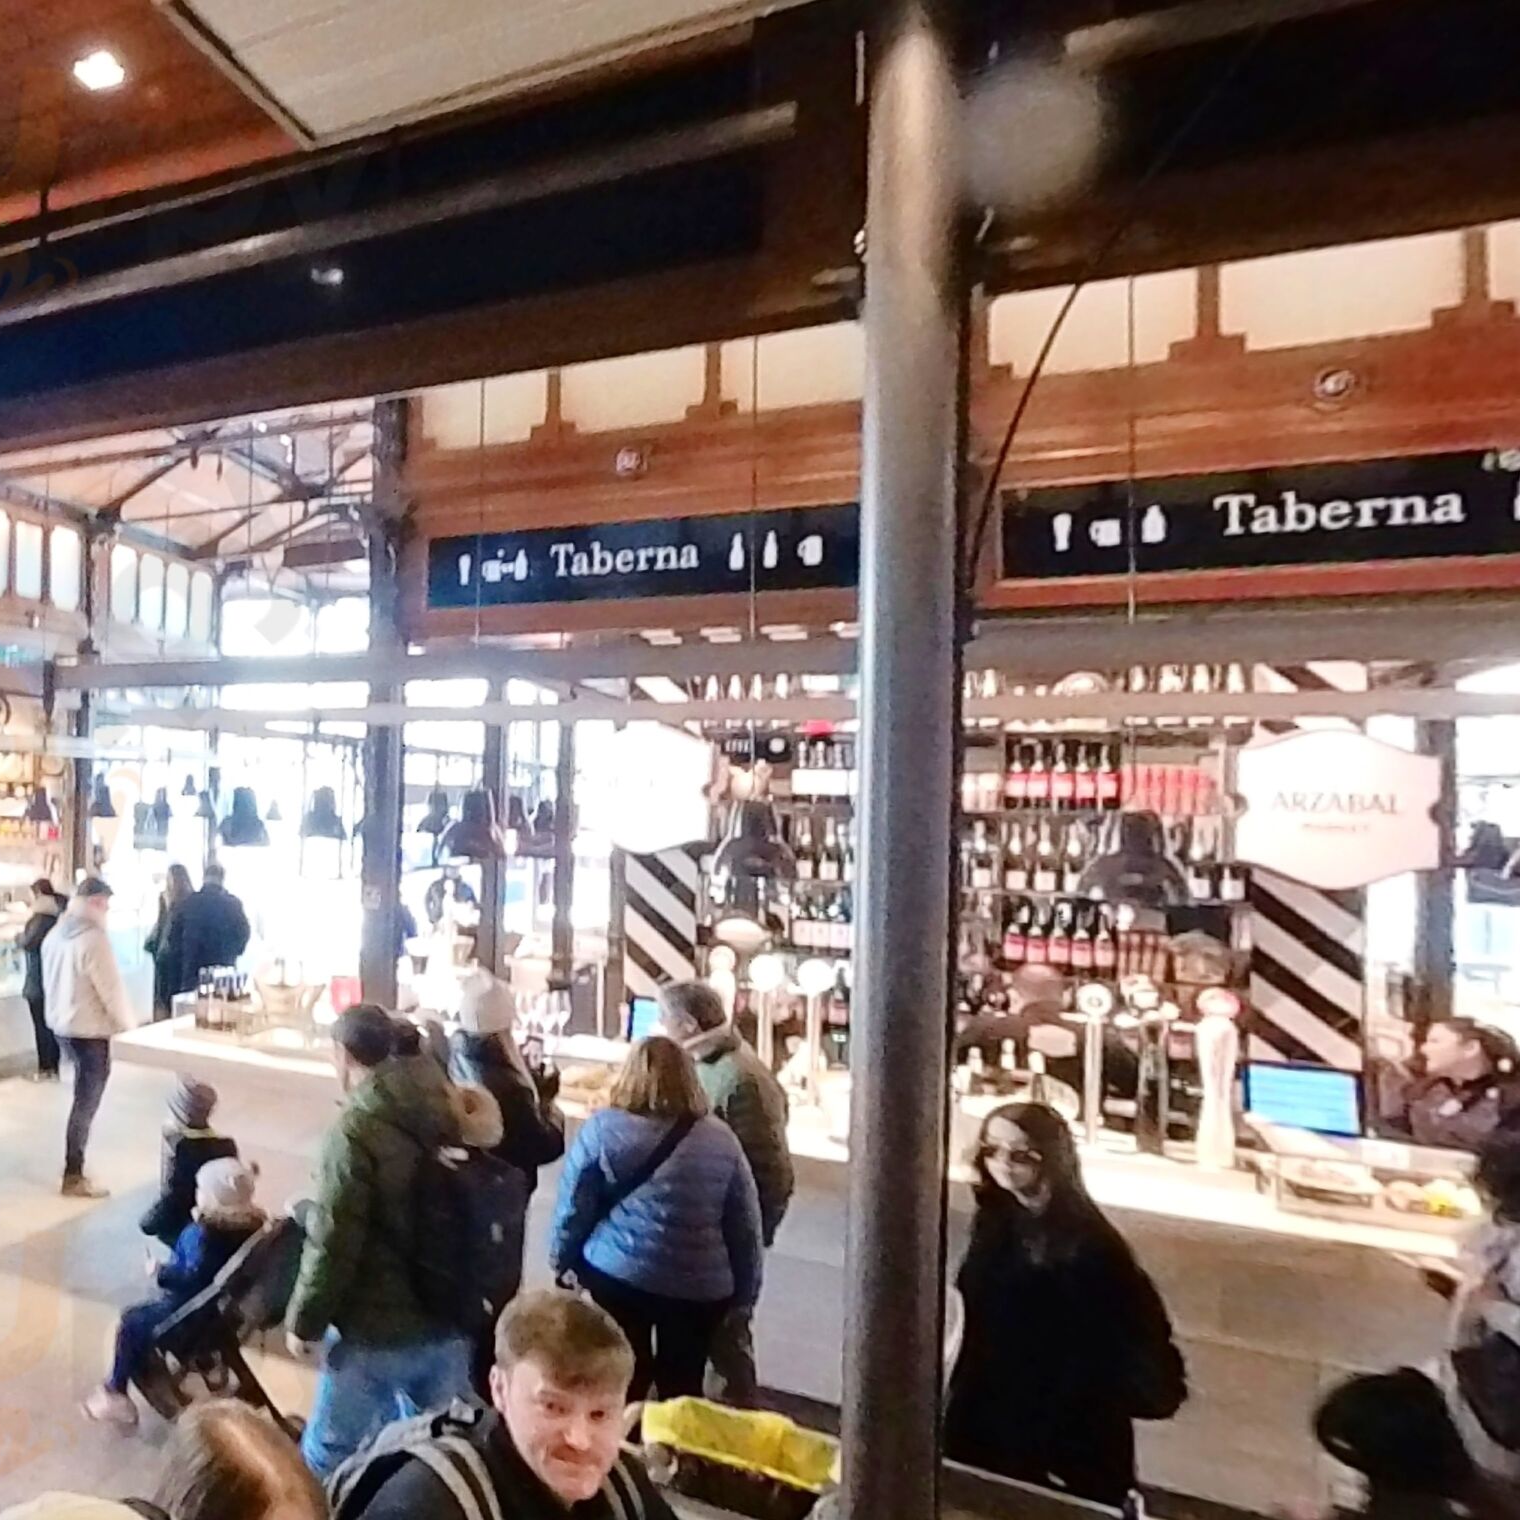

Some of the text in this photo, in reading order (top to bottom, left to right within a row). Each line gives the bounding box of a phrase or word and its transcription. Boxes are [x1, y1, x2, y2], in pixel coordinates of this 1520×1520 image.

[1212, 490, 1467, 537] Taberna
[549, 541, 700, 577] Taberna
[1271, 790, 1405, 816] ARZABAL
